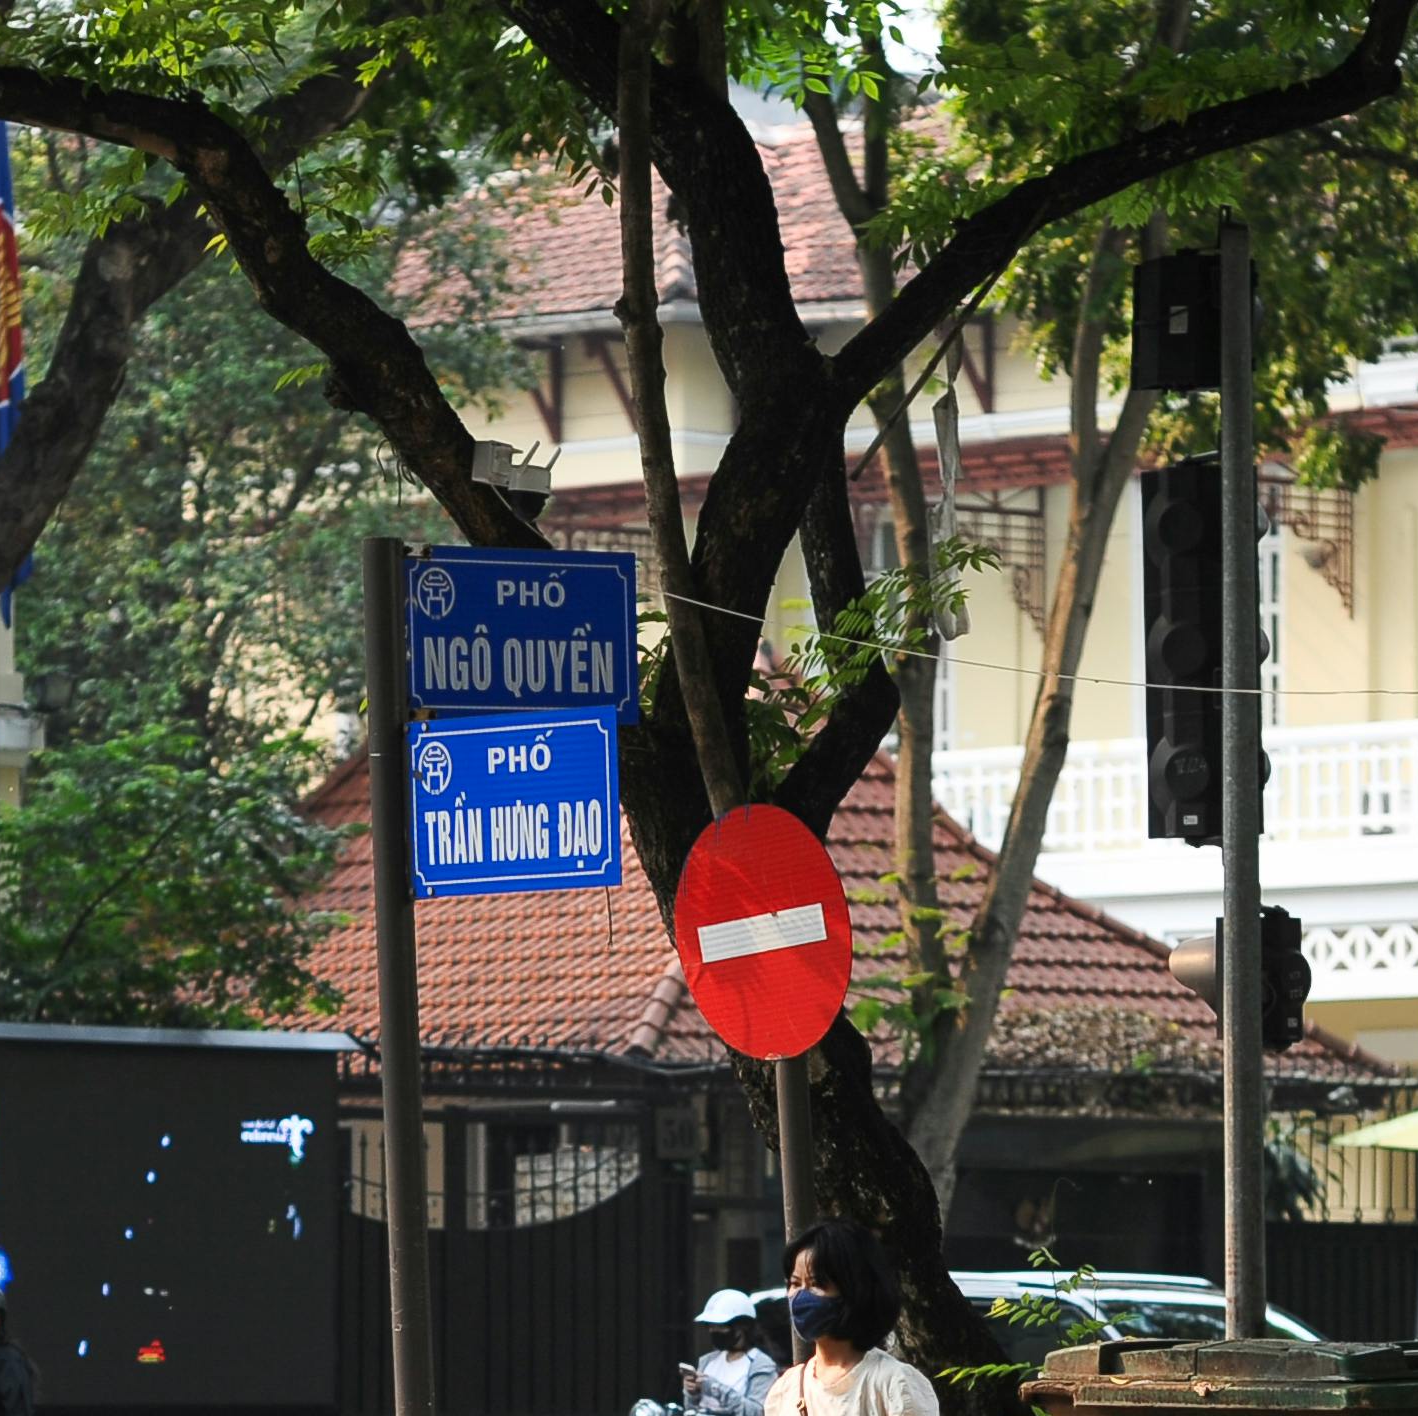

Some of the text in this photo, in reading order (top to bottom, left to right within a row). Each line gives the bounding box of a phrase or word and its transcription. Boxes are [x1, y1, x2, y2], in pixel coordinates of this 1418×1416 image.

[497, 570, 567, 608] PHỐ
[423, 623, 615, 698] NGÔ QUYỀN
[487, 730, 553, 775] PHỐ
[424, 791, 602, 869] TRẦN HƯNG ĐẠO
